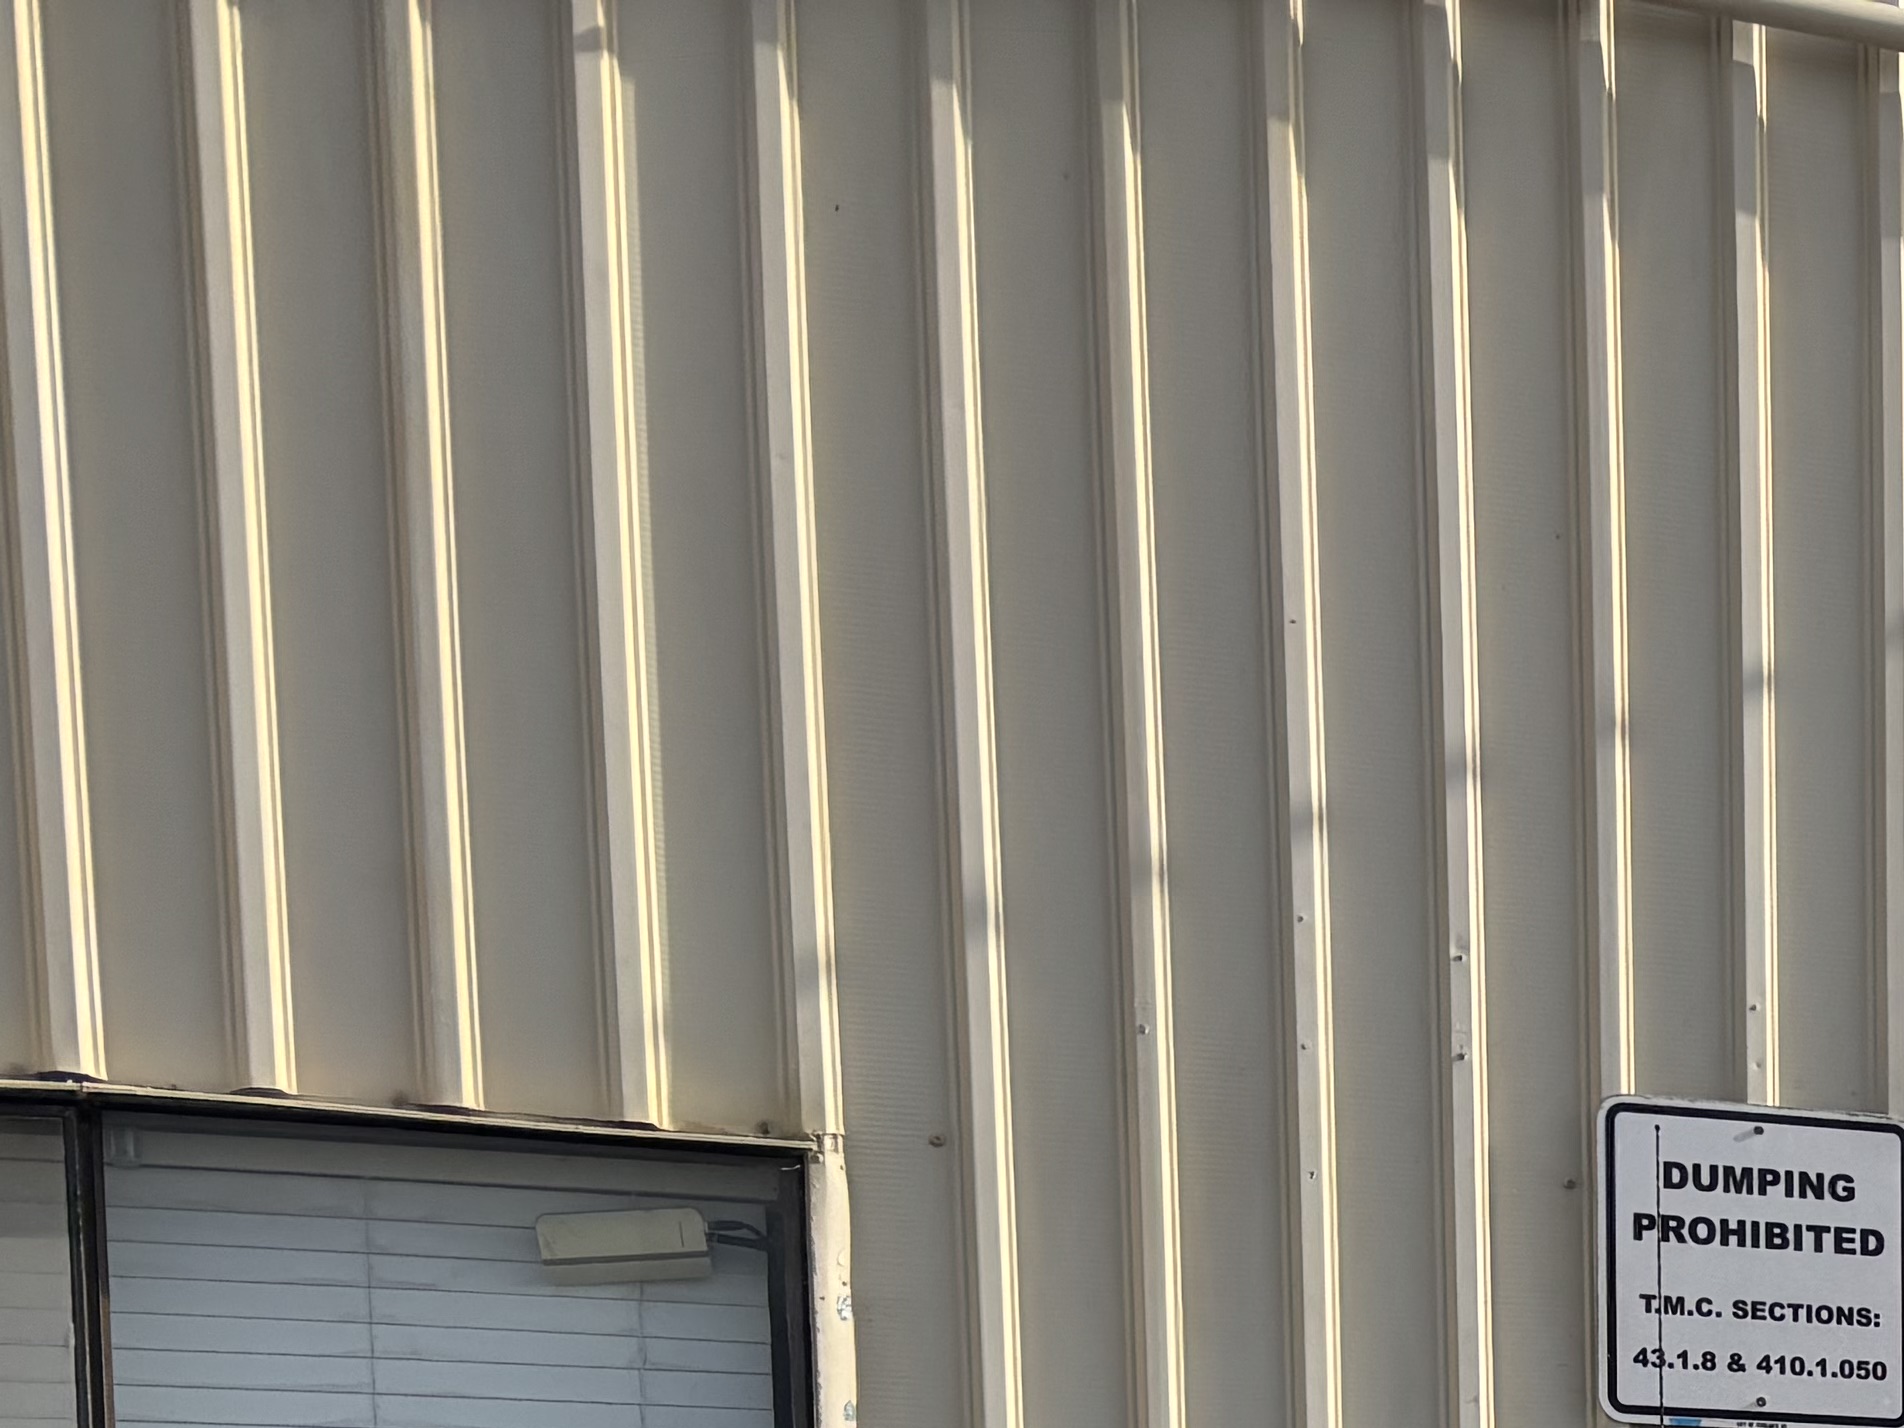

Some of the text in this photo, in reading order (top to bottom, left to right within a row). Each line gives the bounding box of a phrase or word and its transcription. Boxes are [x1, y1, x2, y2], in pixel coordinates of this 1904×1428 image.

[1662, 1160, 1857, 1202] DUMPING
[1632, 1212, 1886, 1257] PROHIBITED
[1639, 1293, 1881, 1328] T.M.C. SECTIONS:
[1632, 1347, 1888, 1382] 43.1.8 & 410.1.050
